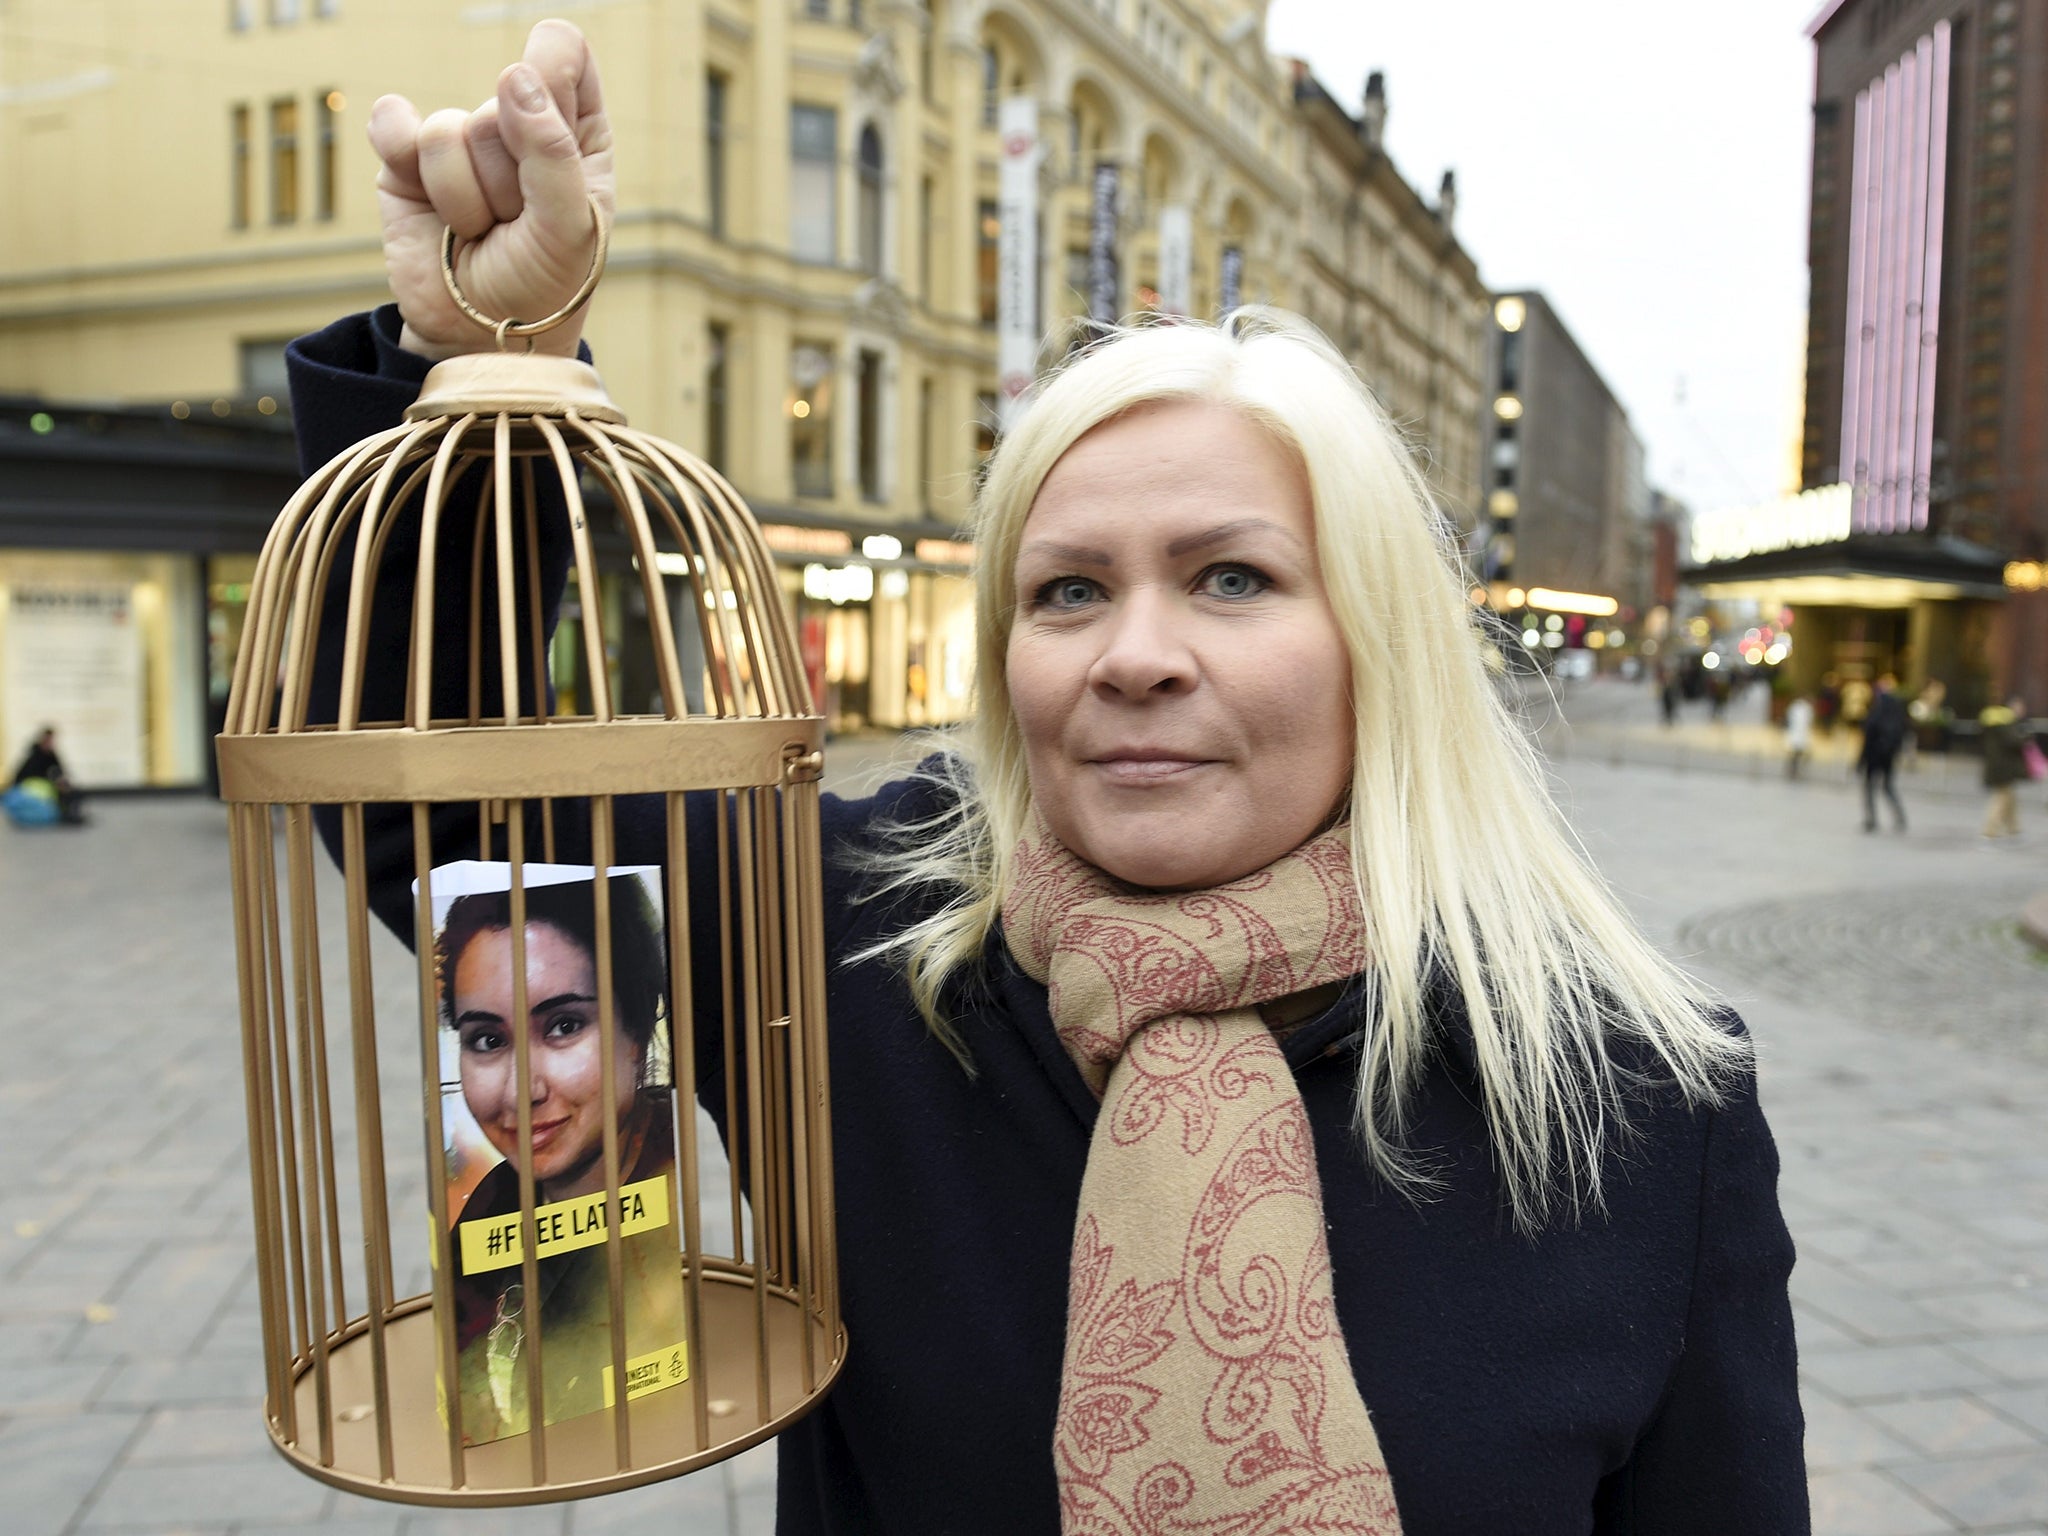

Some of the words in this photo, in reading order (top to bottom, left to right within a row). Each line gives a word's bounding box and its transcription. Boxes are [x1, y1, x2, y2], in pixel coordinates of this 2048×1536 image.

[487, 1213, 565, 1256] #FEE
[572, 1193, 645, 1235] LATFA
[625, 1360, 660, 1384] NESTY
